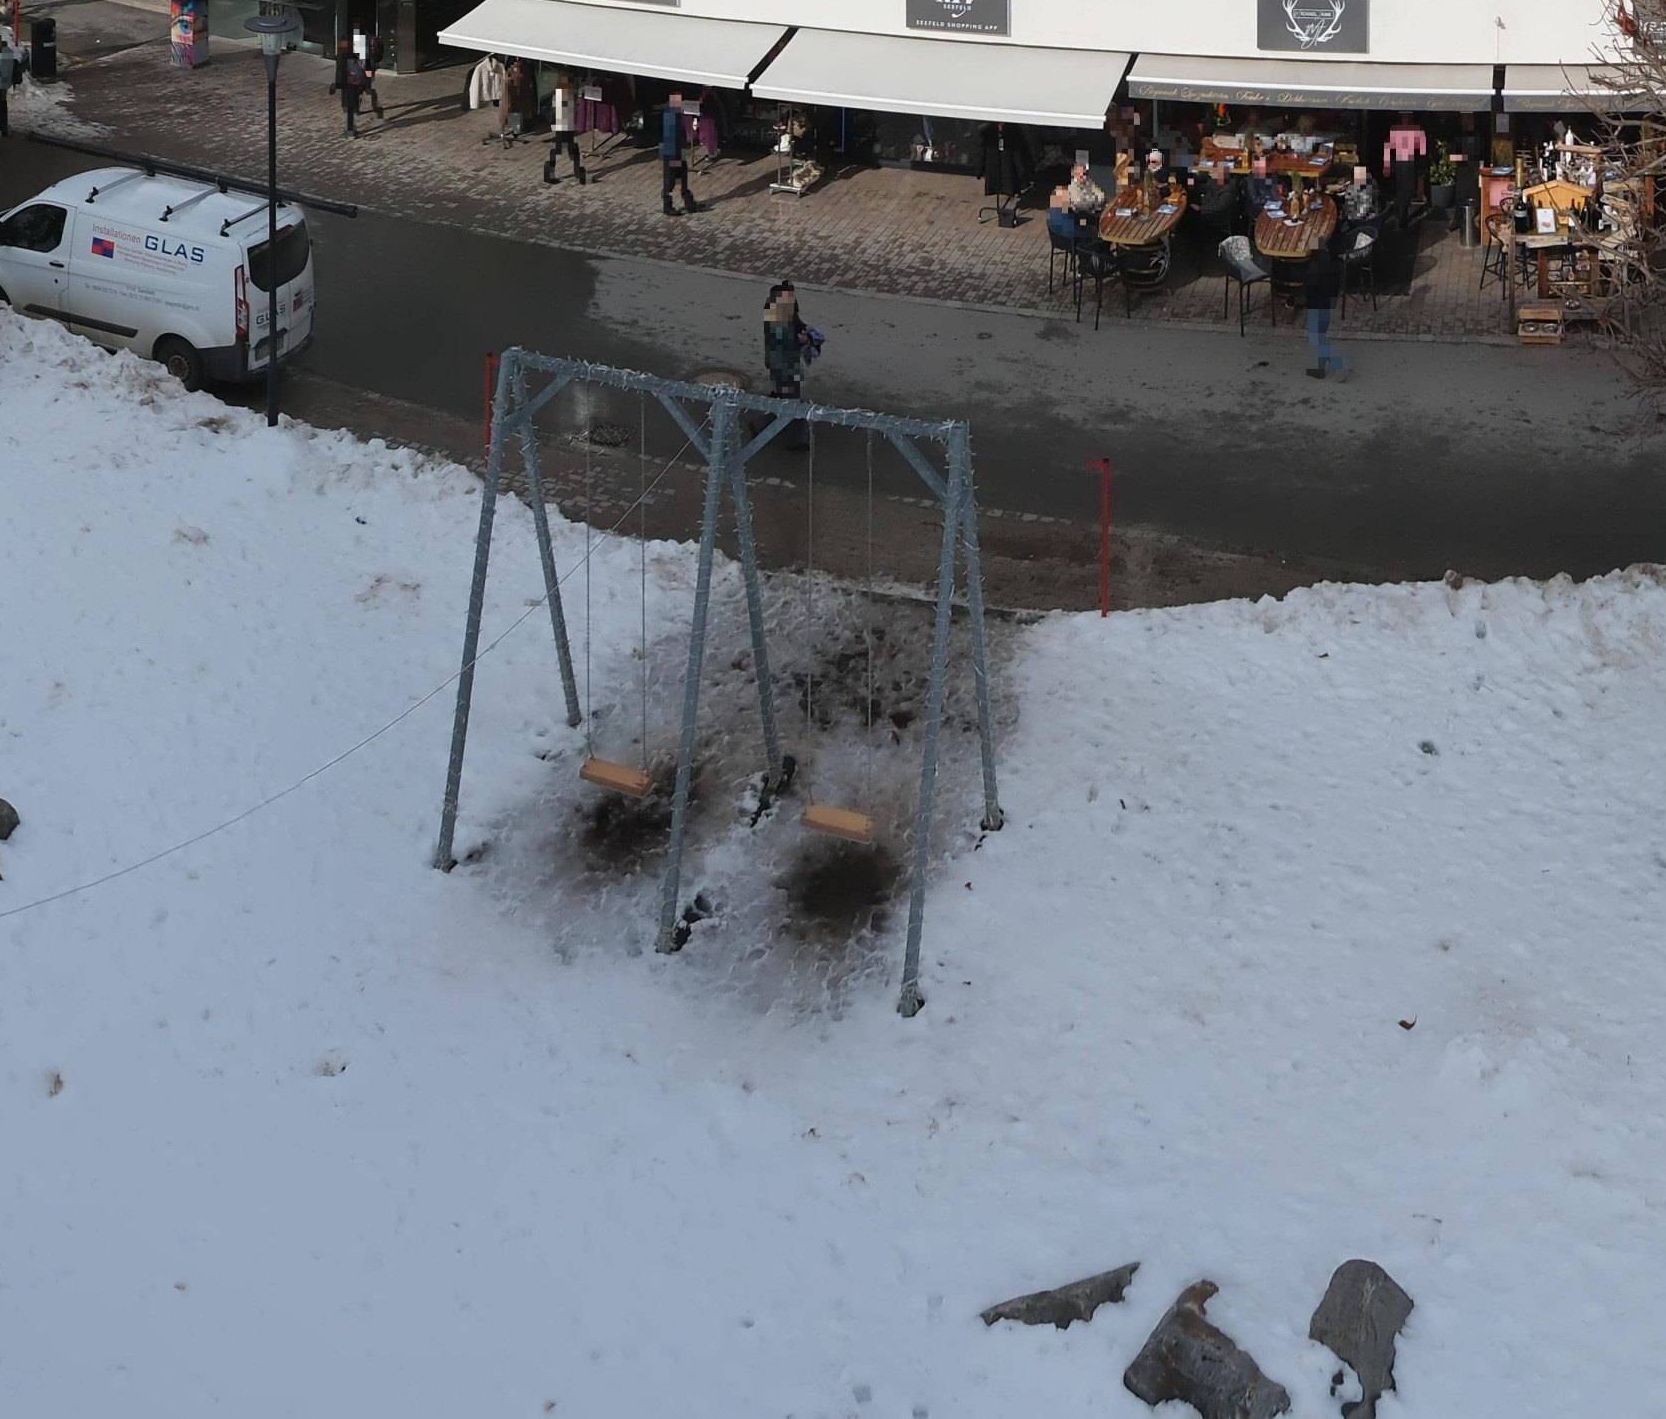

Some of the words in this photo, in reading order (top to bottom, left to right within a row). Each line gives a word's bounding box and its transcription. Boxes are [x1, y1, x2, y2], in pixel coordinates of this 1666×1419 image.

[916, 19, 945, 27] SEEFELD
[947, 21, 983, 30] SHOPPING
[92, 224, 141, 244] Installationen
[144, 234, 205, 263] GLAS
[256, 303, 286, 325] GLS
